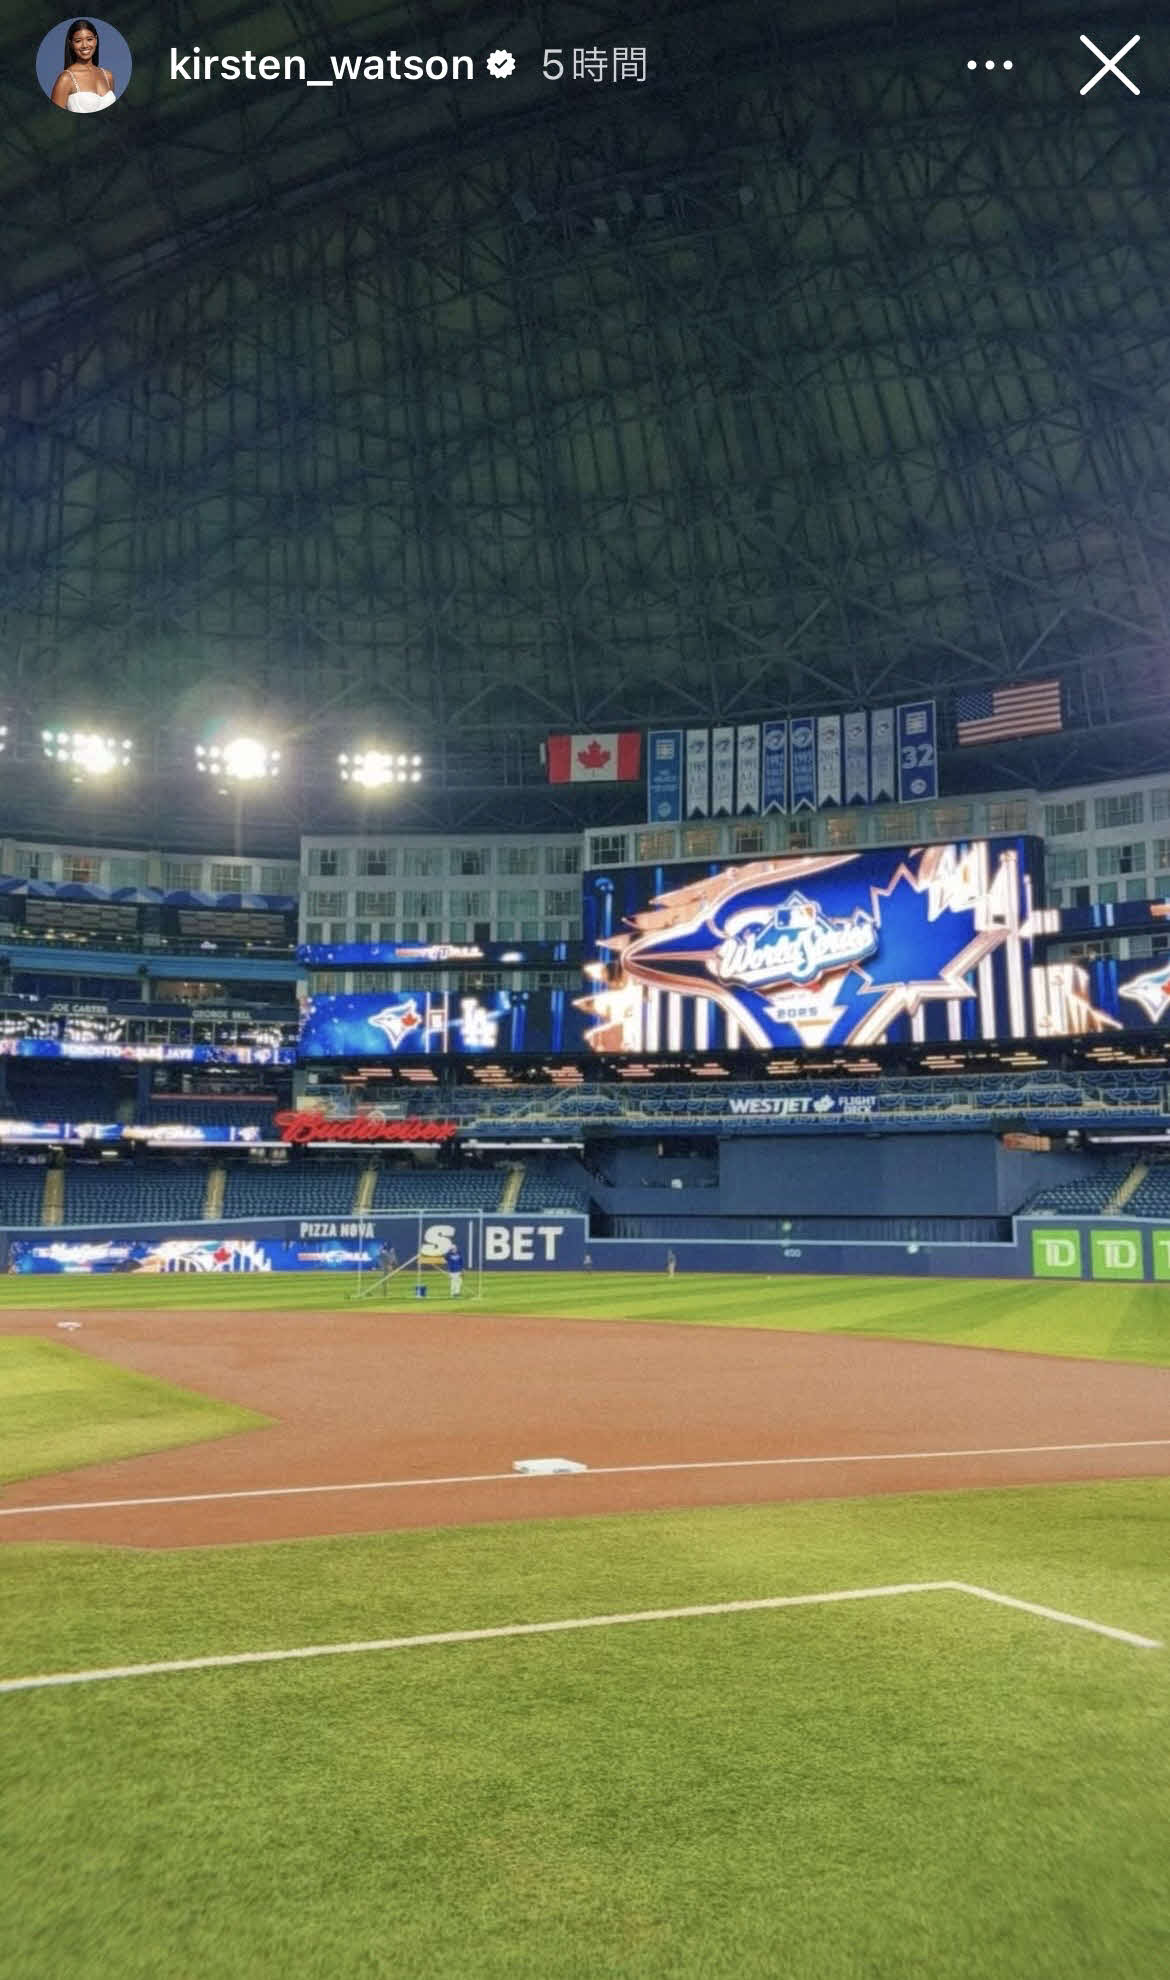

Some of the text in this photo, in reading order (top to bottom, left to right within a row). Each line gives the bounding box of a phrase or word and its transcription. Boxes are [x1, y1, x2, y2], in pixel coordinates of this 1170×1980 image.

[902, 743, 933, 769] 32
[716, 926, 876, 978] World Series
[50, 1004, 108, 1014] JOE CARTER
[777, 1008, 818, 1019] 2025
[729, 1097, 812, 1117] WESTJET
[838, 1096, 876, 1106] FLIGHT
[844, 1105, 872, 1114] DECK
[275, 1110, 457, 1143] Budweiser
[300, 1221, 375, 1239] PIZZA NOVA
[485, 1226, 563, 1261] BET
[1037, 1240, 1076, 1267] TD
[1096, 1240, 1137, 1268] TD
